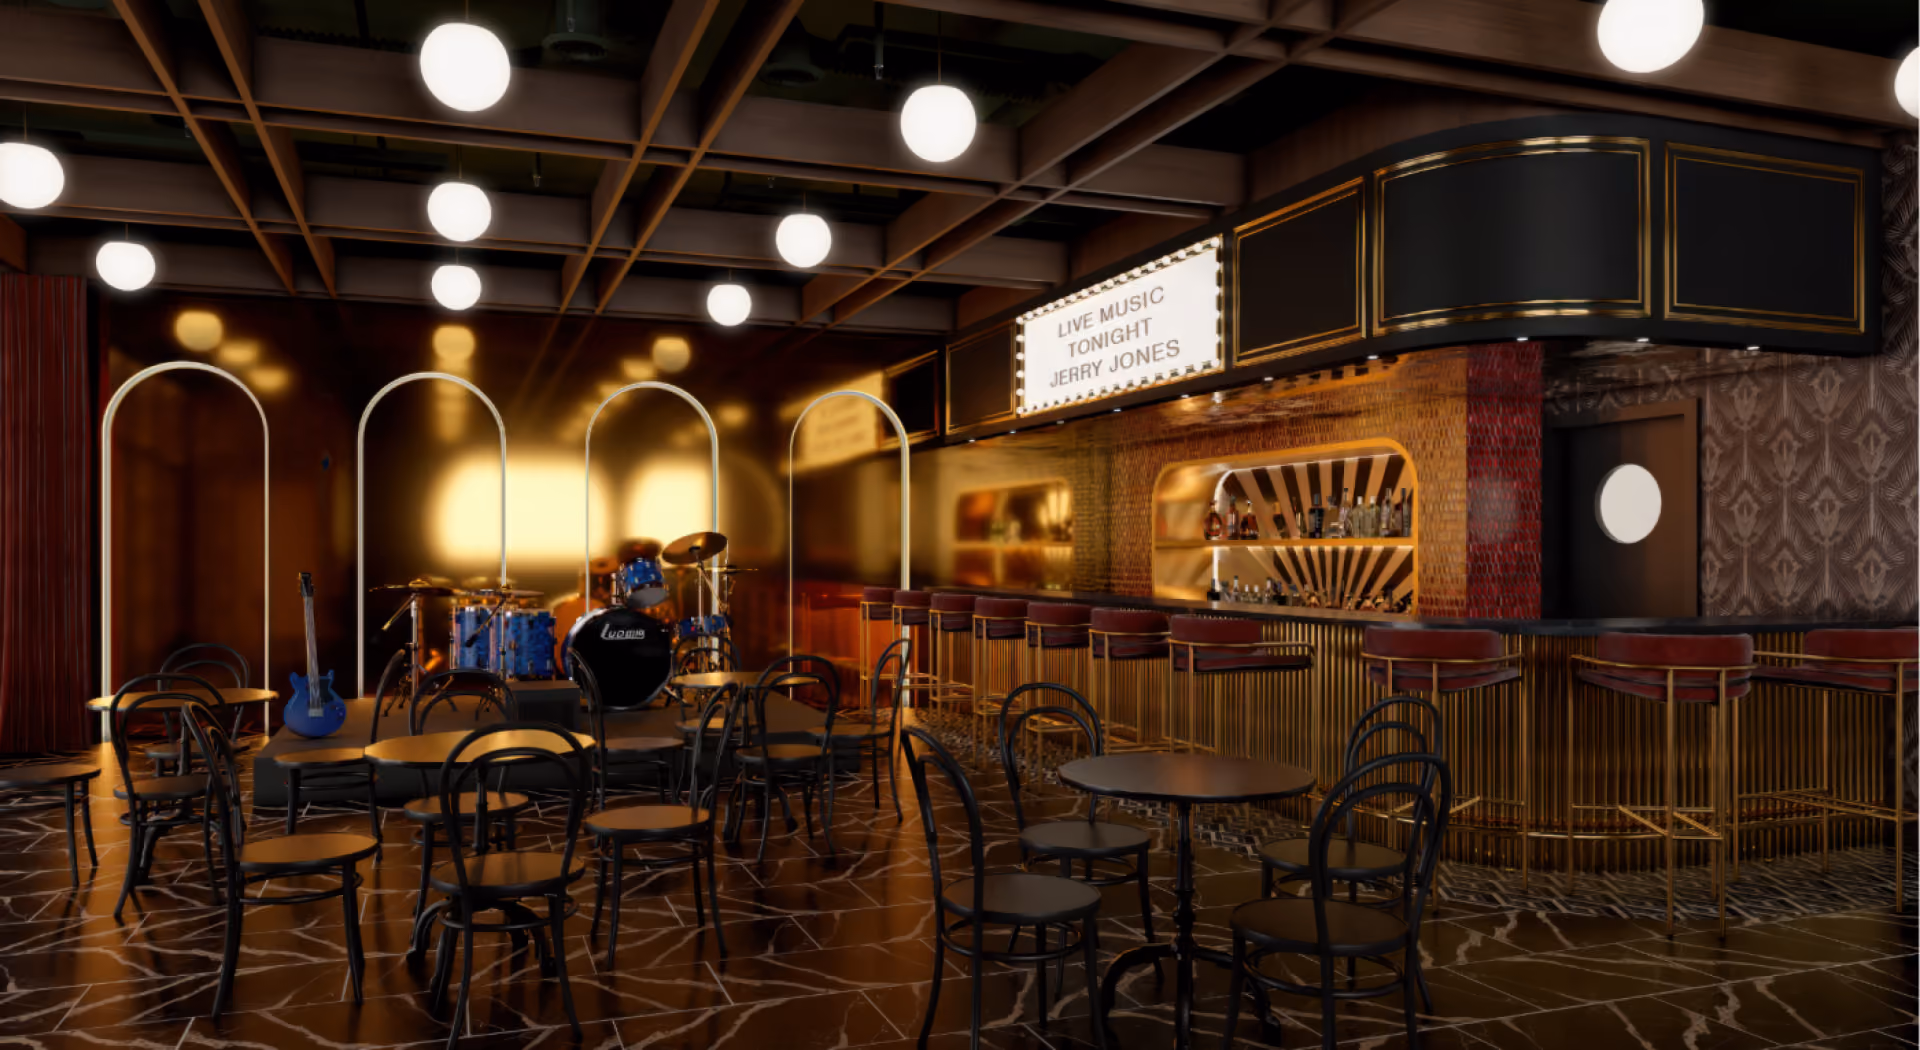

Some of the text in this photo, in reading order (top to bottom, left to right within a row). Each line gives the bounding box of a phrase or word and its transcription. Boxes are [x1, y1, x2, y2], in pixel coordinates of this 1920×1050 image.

[1058, 286, 1164, 338] LIVE MUSIC
[1068, 318, 1152, 358] TONIGHT
[1050, 339, 1180, 388] JERRY JONES
